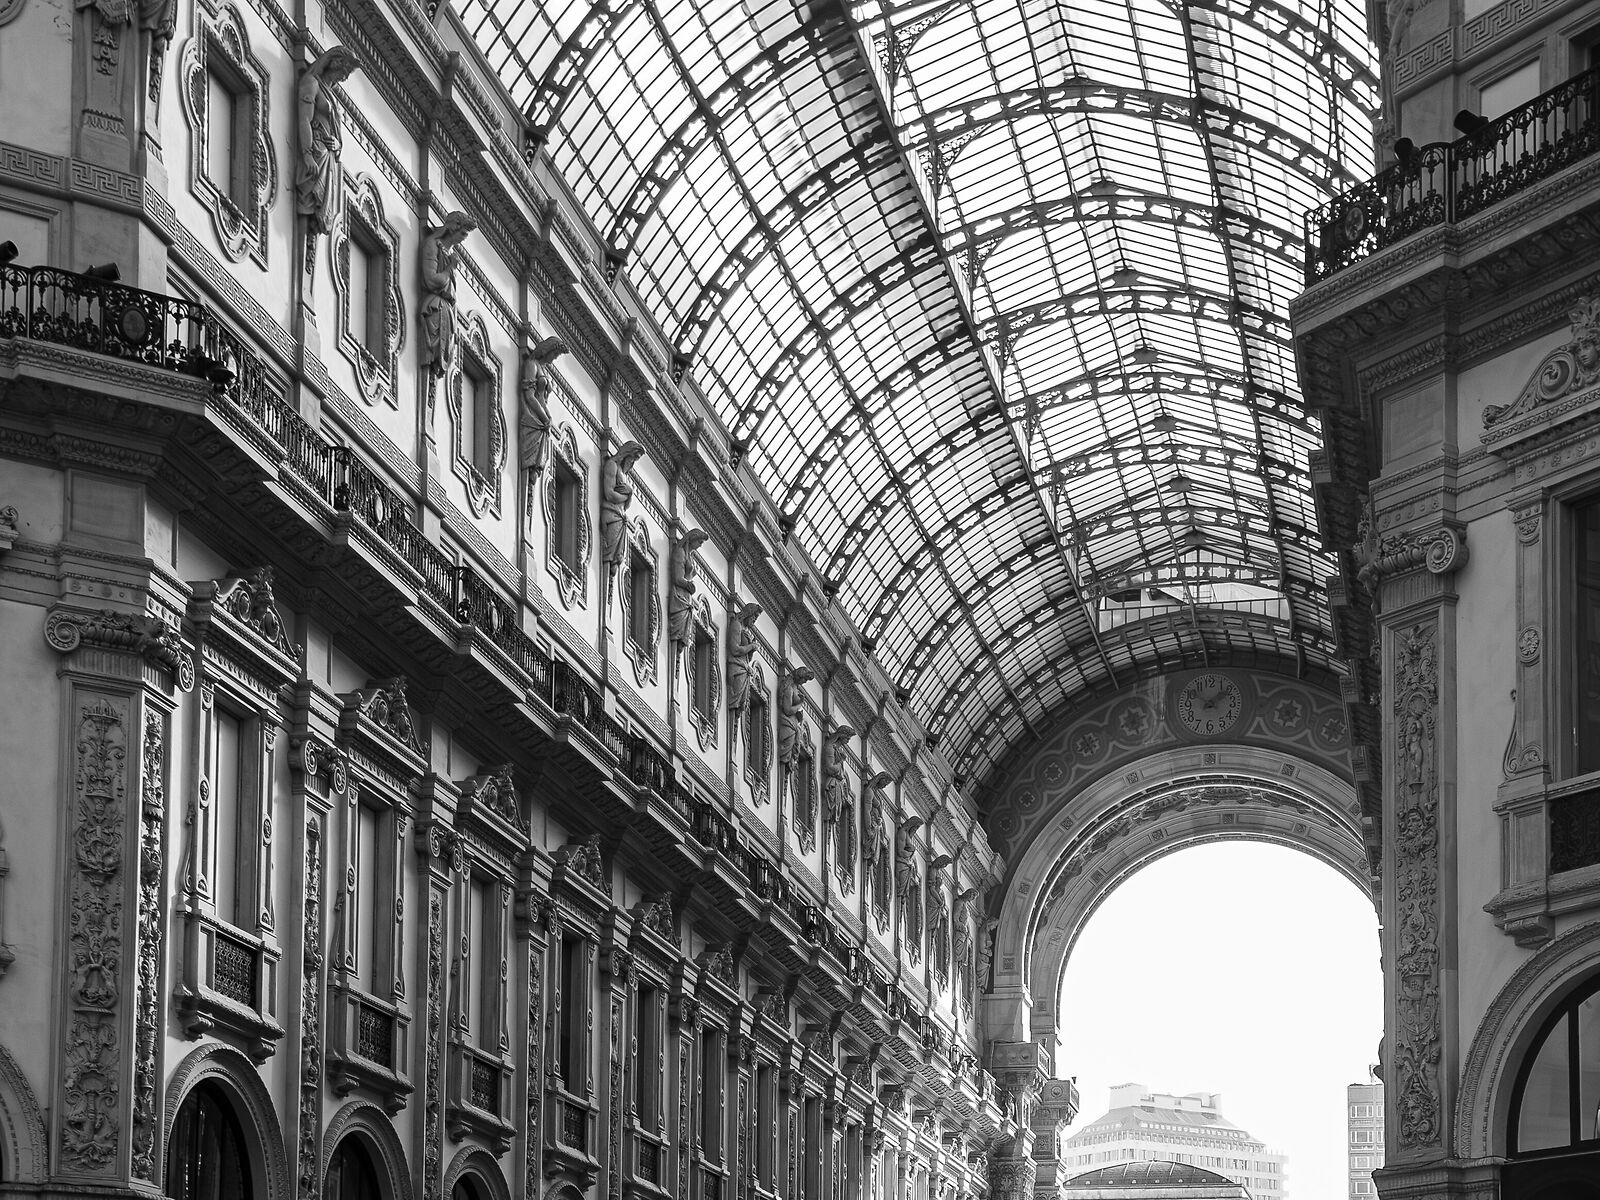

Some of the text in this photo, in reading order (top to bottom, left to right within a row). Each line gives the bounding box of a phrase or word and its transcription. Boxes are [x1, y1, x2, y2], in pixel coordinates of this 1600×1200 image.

[1205, 677, 1216, 689] 12
[1226, 685, 1233, 696] 2
[1184, 700, 1192, 711] 9
[1229, 695, 1236, 708] 3
[1187, 710, 1195, 723] 8
[1225, 709, 1235, 721] 4
[1195, 719, 1202, 732] 7
[1205, 720, 1214, 732] 6
[1219, 716, 1226, 729] 5
